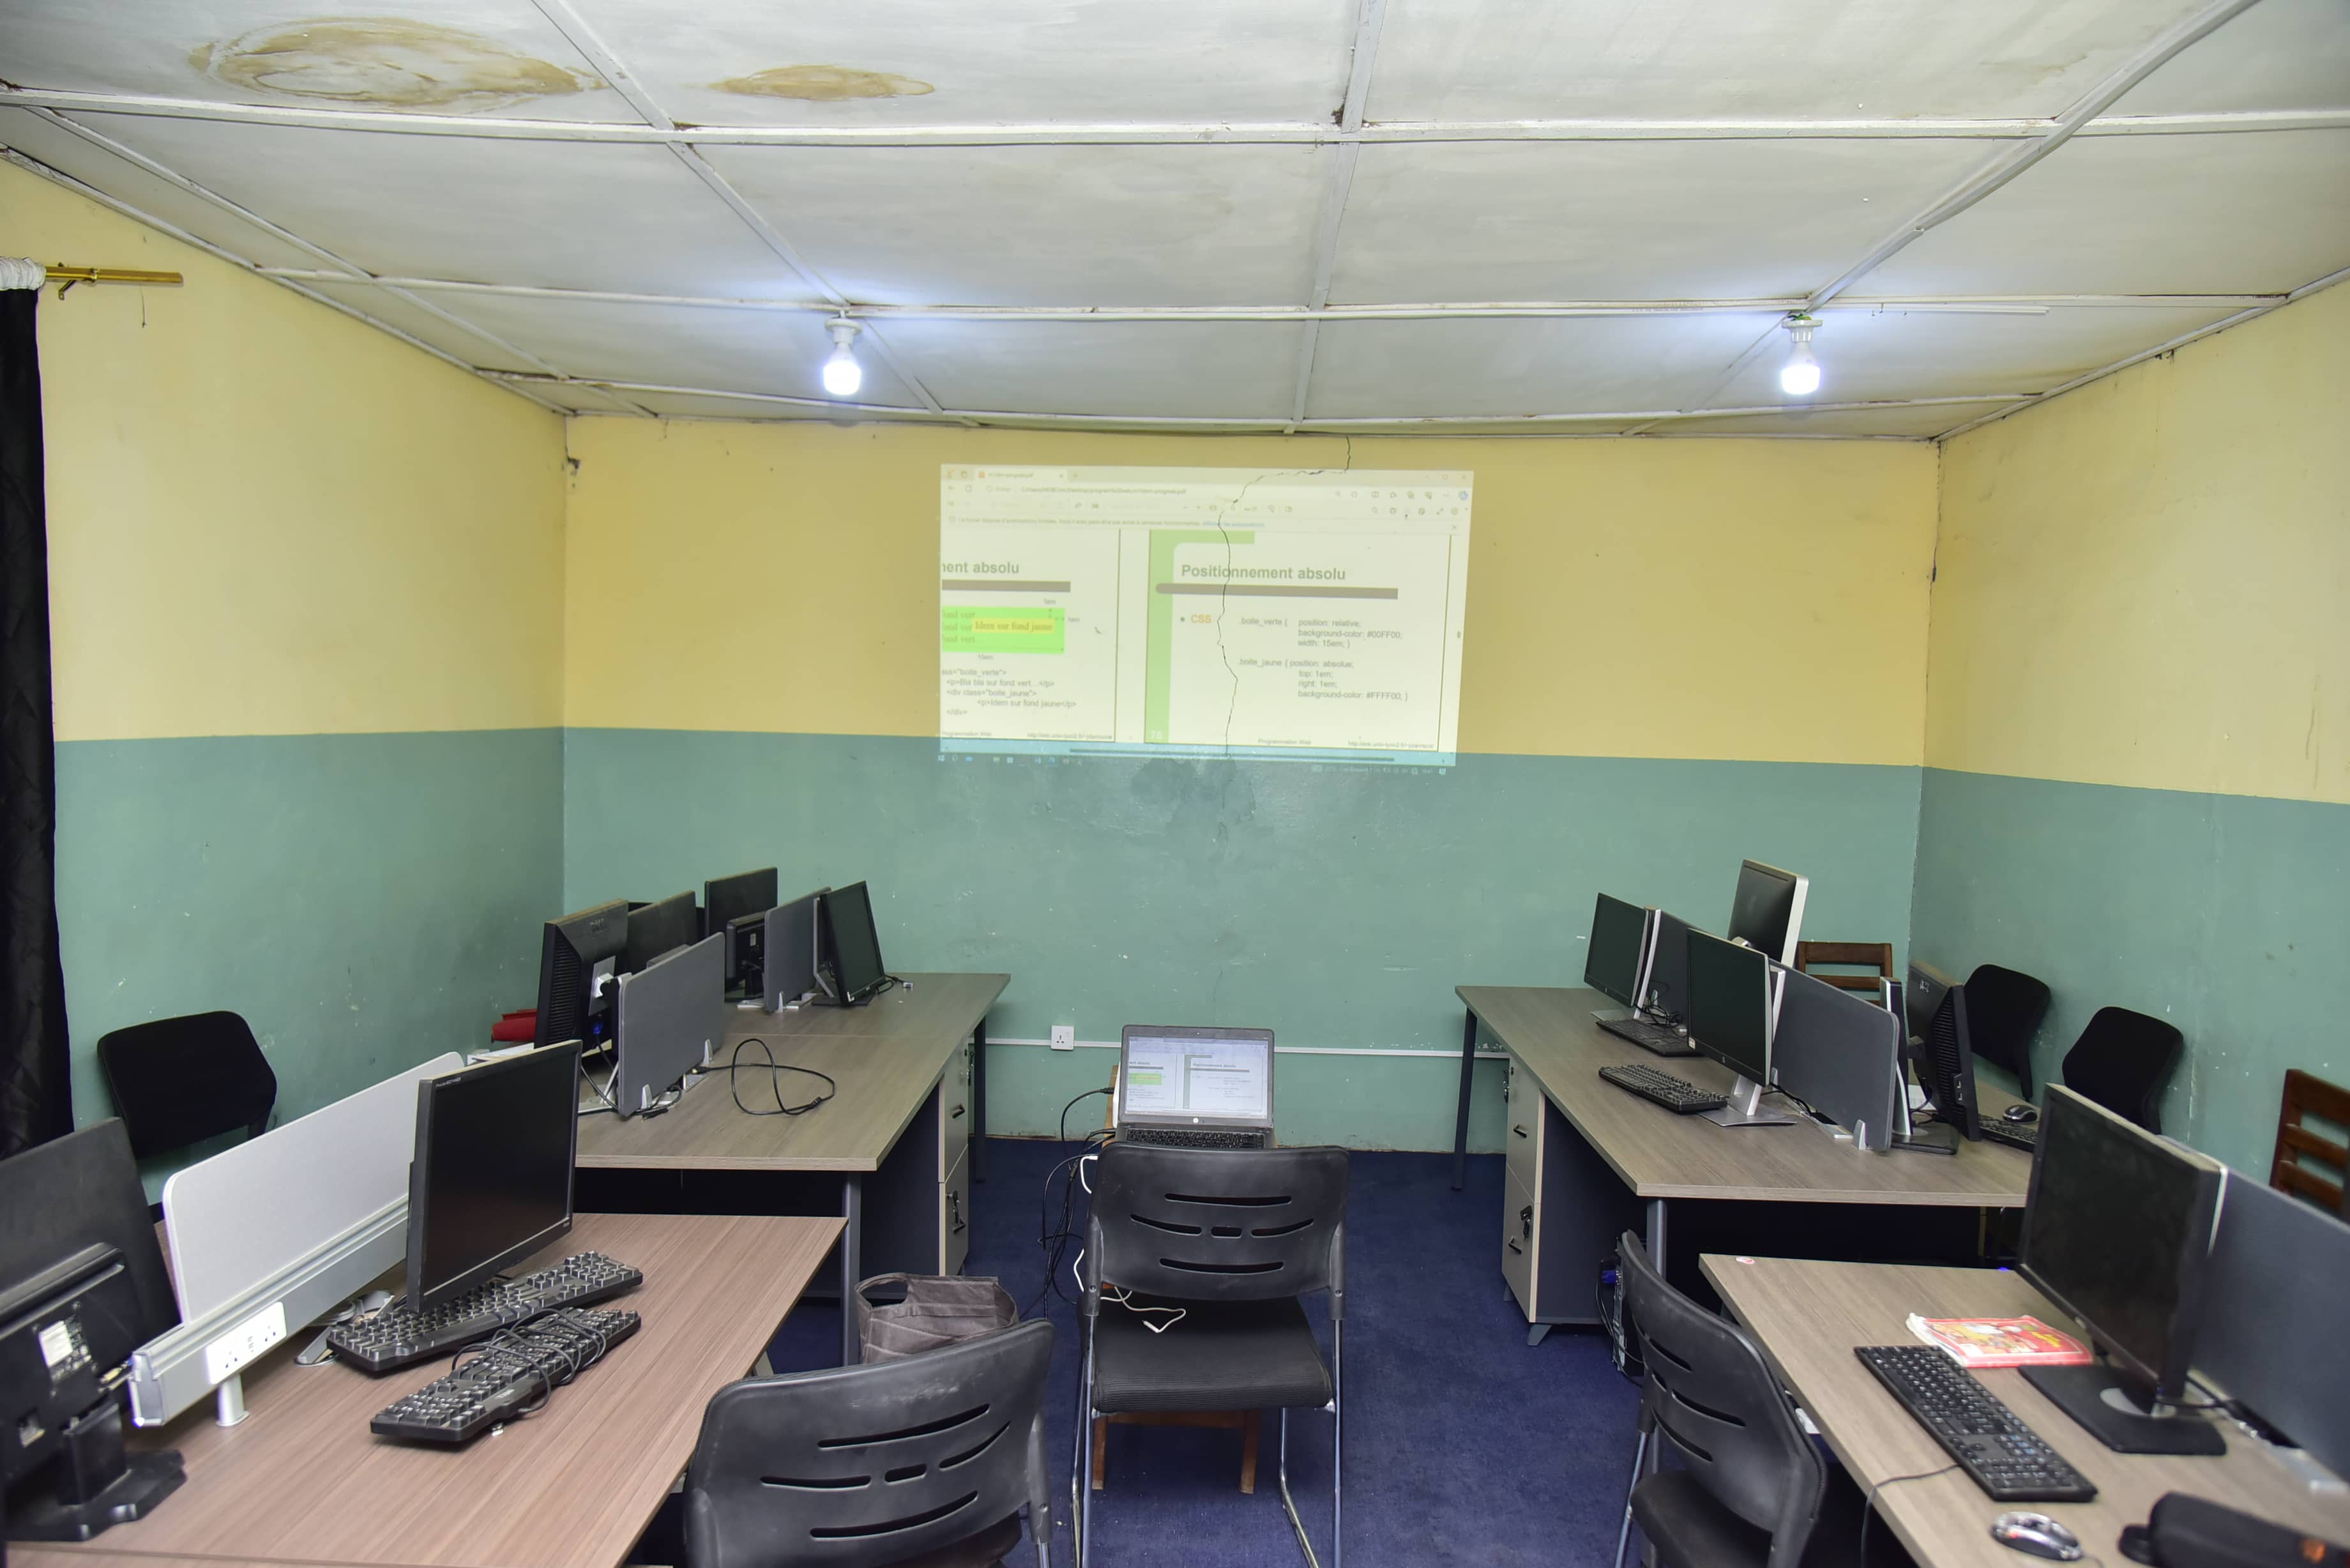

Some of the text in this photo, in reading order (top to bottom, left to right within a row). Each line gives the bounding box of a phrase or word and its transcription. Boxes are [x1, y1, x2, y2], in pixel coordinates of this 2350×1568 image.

[973, 562, 1020, 574] absolu
[1181, 564, 1346, 580] Positionnement absolu
[1191, 614, 1212, 624] CSS
[975, 621, 995, 630] Idem
[1012, 622, 1029, 631] fond
[1031, 622, 1054, 633] jaune
